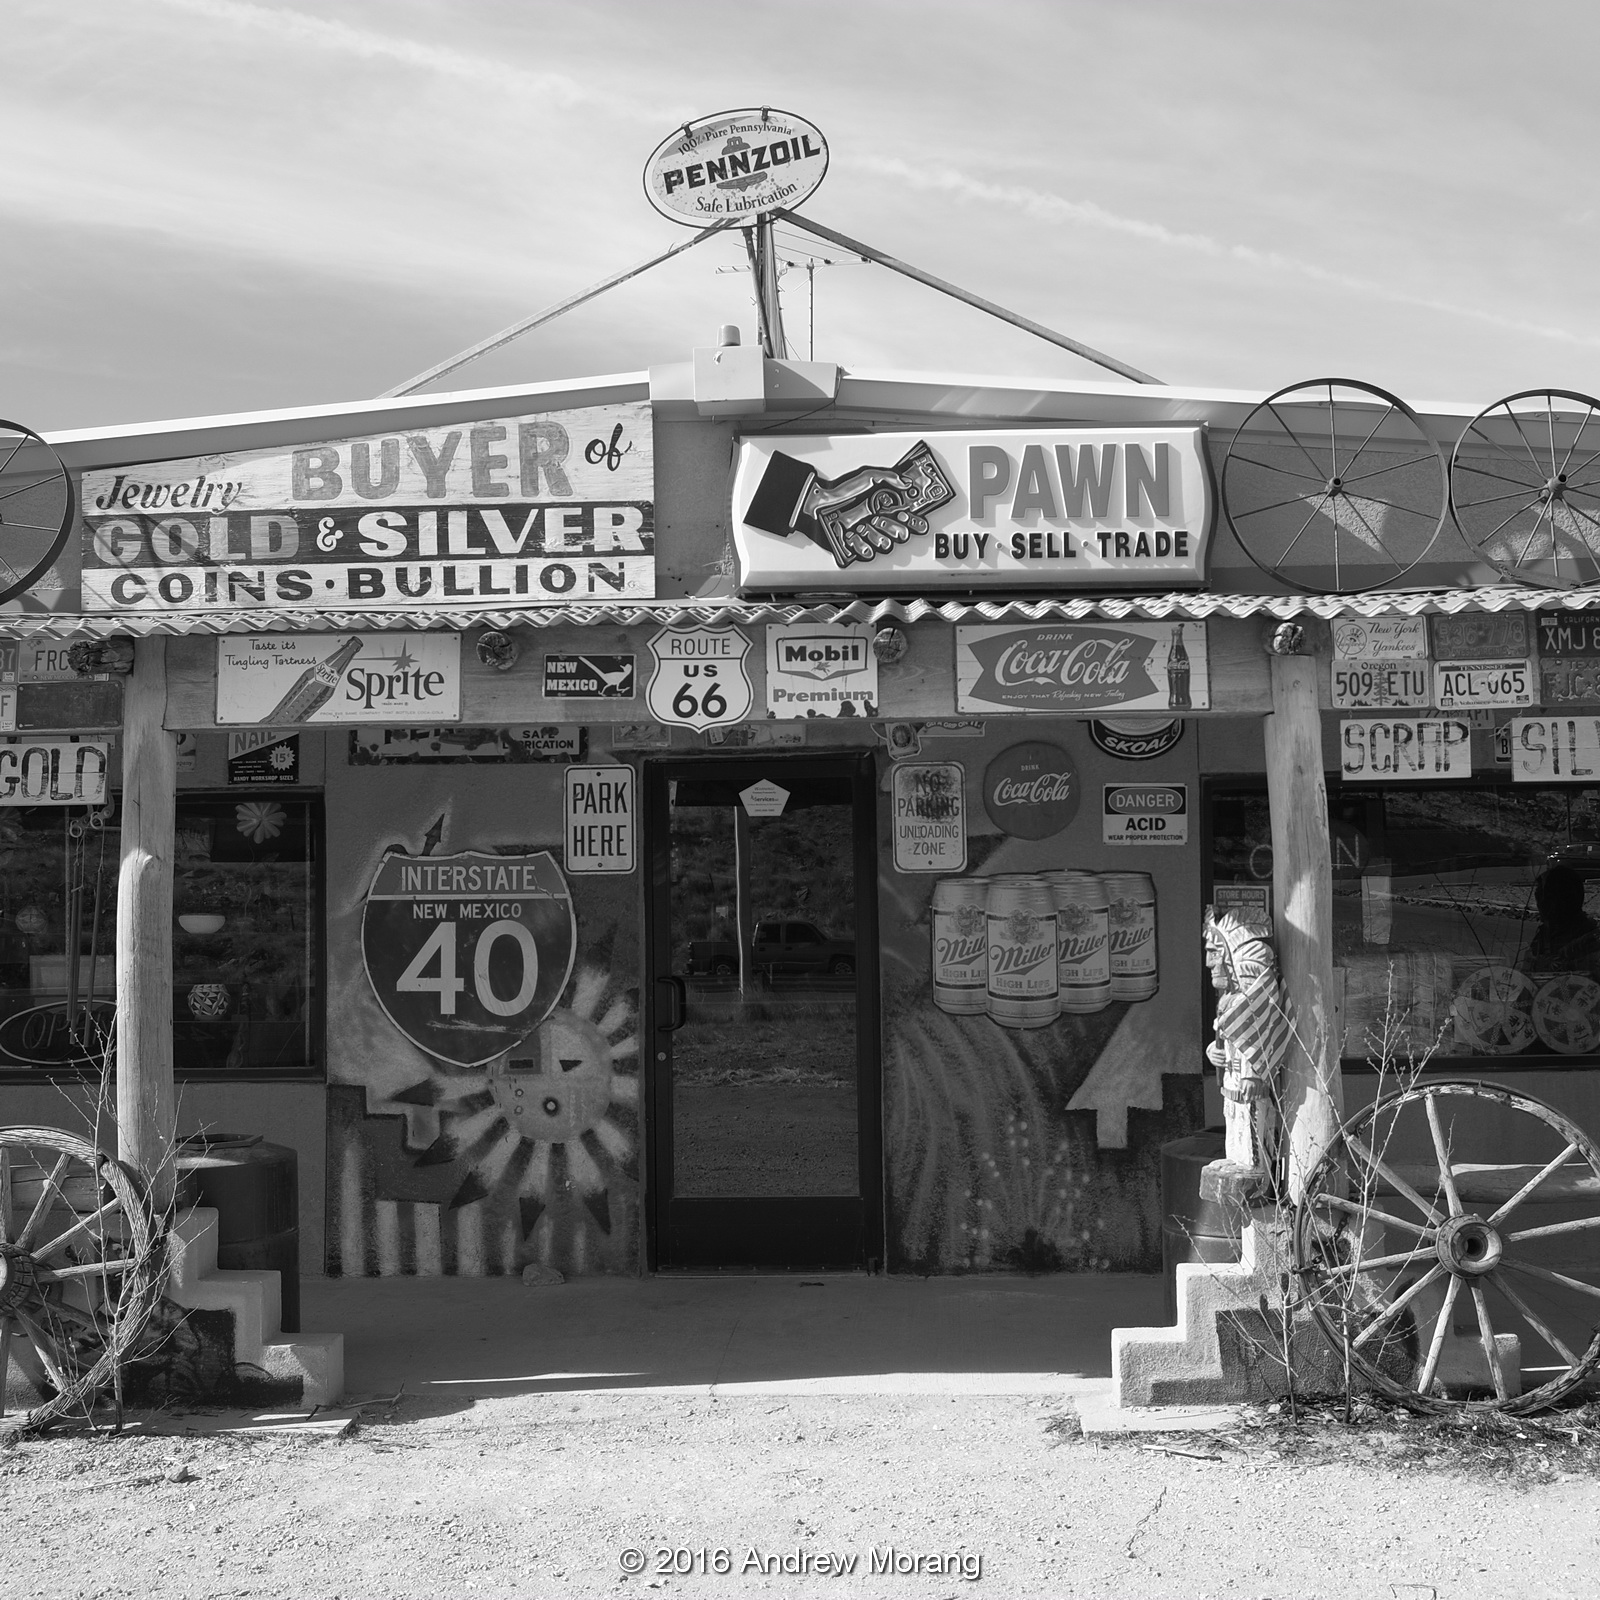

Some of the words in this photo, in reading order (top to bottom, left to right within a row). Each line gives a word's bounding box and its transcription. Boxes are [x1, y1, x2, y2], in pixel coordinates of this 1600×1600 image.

[705, 128, 728, 141] Pure
[730, 123, 792, 136] Pennsylvania
[663, 134, 821, 195] PENNZOIL
[695, 196, 723, 213] Safe
[726, 183, 798, 212] Lubrication
[291, 420, 573, 501] BUYER
[585, 423, 633, 472] of
[967, 441, 1170, 520] PAWN
[96, 473, 243, 514] Jewelry
[93, 513, 300, 566] GOLD
[315, 516, 343, 553] &
[357, 506, 645, 558] SILVER
[934, 531, 990, 561] BUY
[1010, 532, 1077, 559] SELL
[1097, 531, 1190, 558] TRADE
[1037, 633, 1074, 641] DRINK
[1366, 621, 1392, 634] New
[1392, 621, 1421, 639] York
[1545, 627, 1586, 650] XMJ
[249, 638, 277, 650] Taste
[281, 641, 296, 650] its
[671, 638, 731, 655] ROUTE
[785, 644, 859, 662] Mobil
[1371, 639, 1416, 657] Yankees
[224, 654, 269, 670] Tingling
[272, 654, 317, 666] Tartness
[547, 661, 578, 674] NEW
[683, 664, 718, 678] US
[995, 638, 1136, 687] Coca-Cola
[1361, 661, 1397, 671] Oregon
[1459, 663, 1506, 671] TENNESSEE
[316, 663, 343, 684] Sprite
[345, 666, 445, 710] Sprite
[546, 678, 598, 691] MEXICO
[1335, 671, 1373, 697] 509
[1387, 670, 1425, 697] ETU
[672, 682, 728, 718] 66
[773, 688, 874, 702] Premium
[502, 740, 574, 749] LRICATION
[1104, 734, 1170, 753] SKOAL
[1344, 720, 1469, 775] SCRAP
[0, 745, 106, 801] GOLD
[572, 782, 628, 814] PARK
[993, 772, 1072, 807] Coca-Cola
[1116, 794, 1175, 808] DANGER
[899, 825, 959, 839] UNLOADING
[1125, 817, 1167, 831] ACID
[573, 825, 628, 857] HERE
[913, 842, 946, 856] ZONE
[400, 865, 536, 892] INTERSTATE
[1217, 890, 1240, 899] STORE
[1241, 890, 1265, 899] HOURS
[412, 903, 447, 919] NEW
[459, 903, 522, 919] MEXICO
[936, 936, 986, 964] Mill
[989, 943, 1055, 973] Miller
[396, 919, 539, 1017] 40
[971, 969, 986, 978] LIF
[996, 978, 1023, 989] HIGH
[1027, 979, 1050, 989] LIFE
